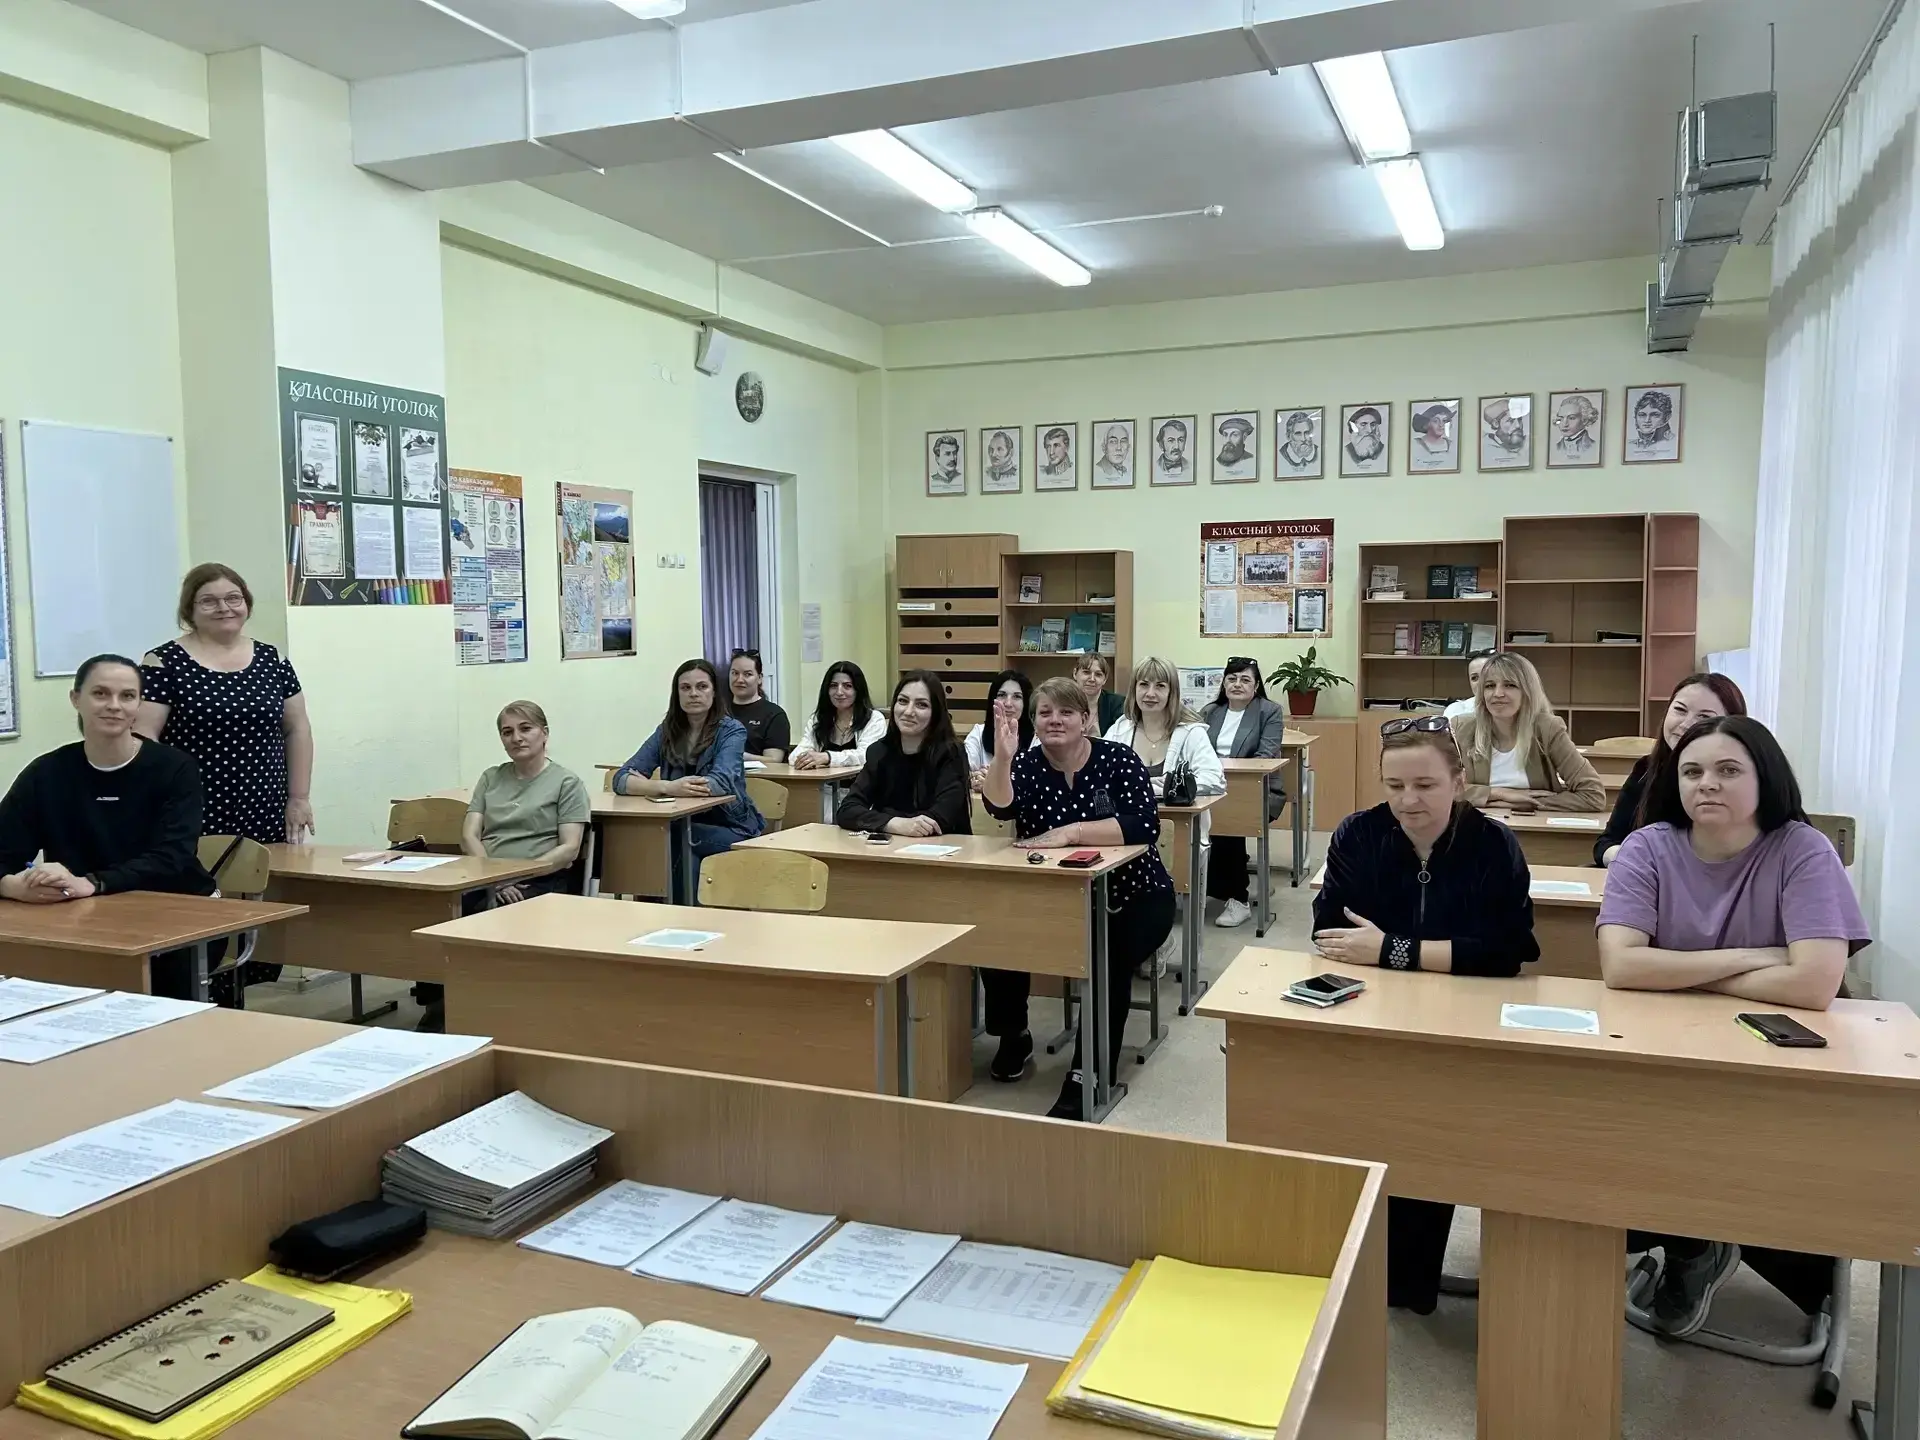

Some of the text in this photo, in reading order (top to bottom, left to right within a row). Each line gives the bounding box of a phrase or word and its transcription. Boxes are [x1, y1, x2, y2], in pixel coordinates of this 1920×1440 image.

[289, 381, 438, 419] КЛАССНЫЙ УГОЛОК
[1212, 524, 1321, 535] КЛАССНЫЙ УГОЛОК
